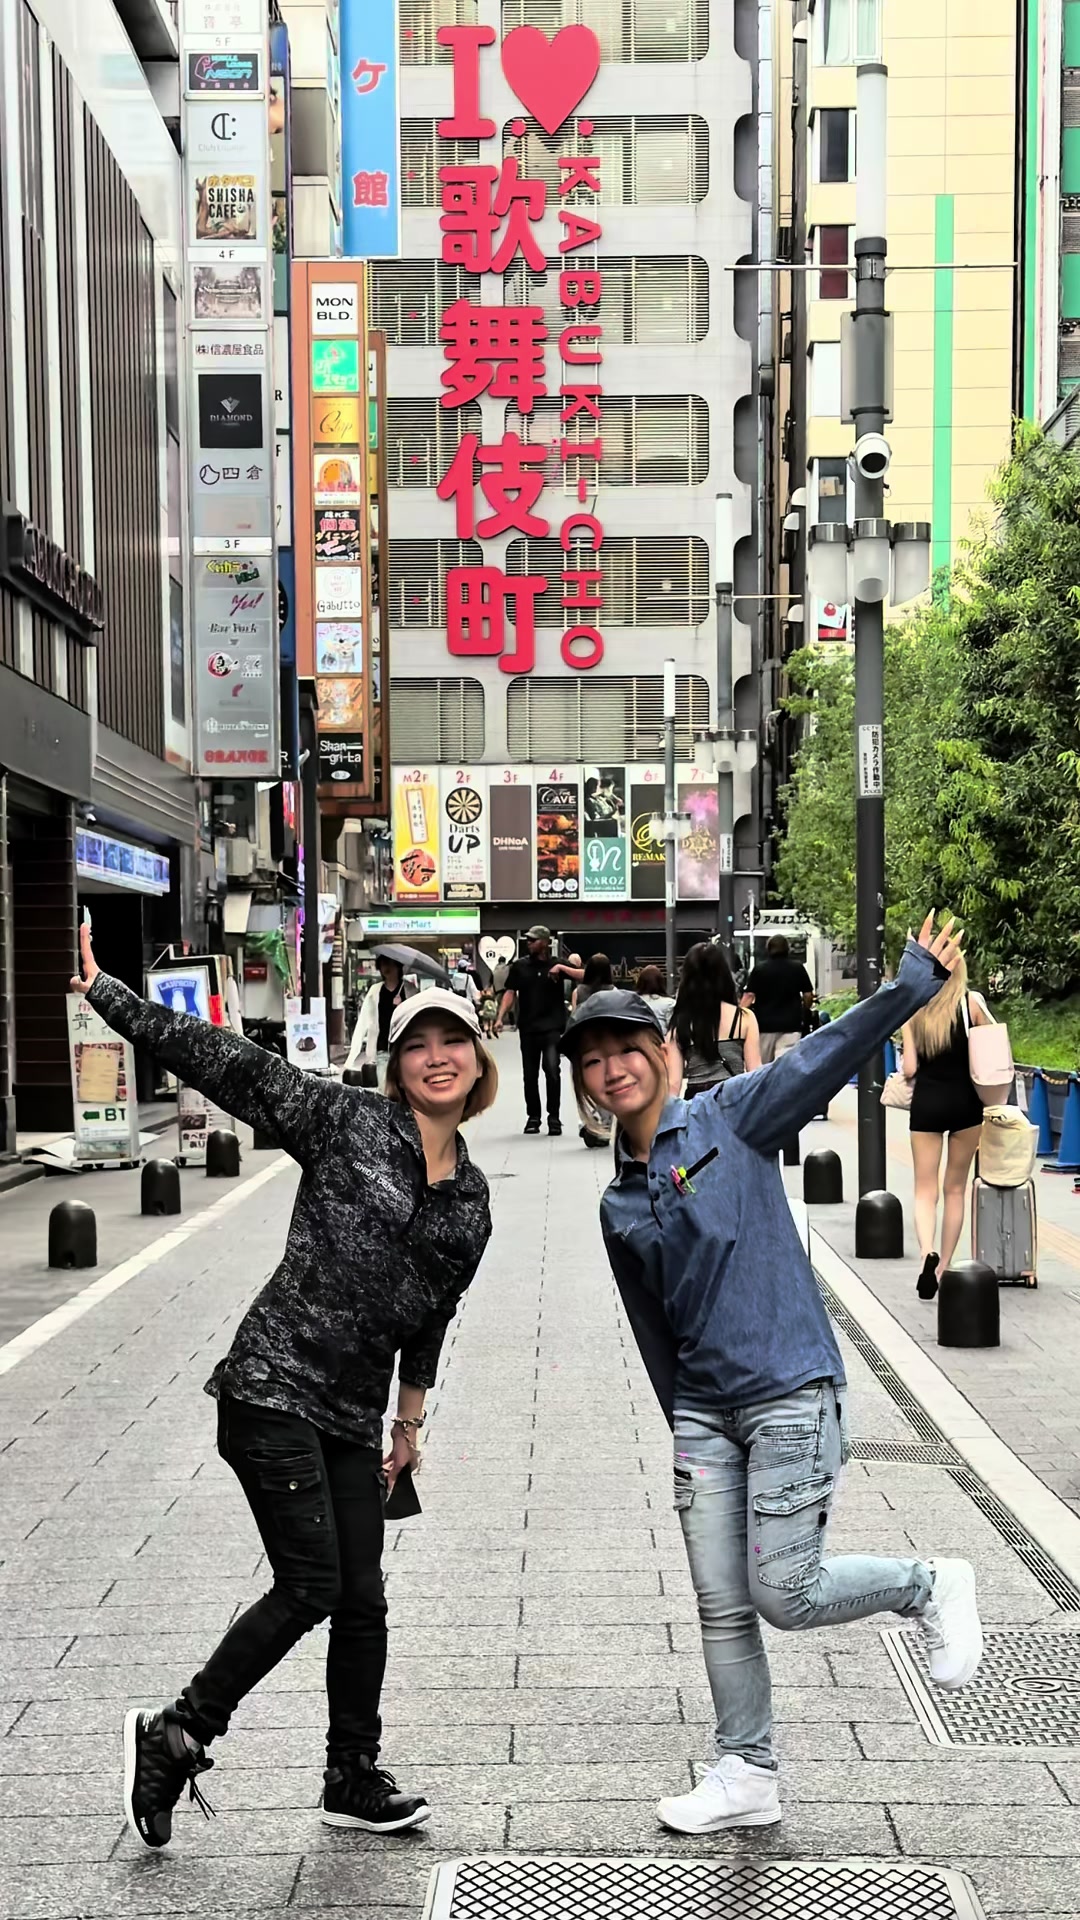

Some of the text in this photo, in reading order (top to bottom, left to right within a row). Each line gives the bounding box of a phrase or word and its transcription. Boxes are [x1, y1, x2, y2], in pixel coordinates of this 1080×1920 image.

[436, 25, 496, 138] I
[208, 188, 254, 202] SHISHA
[208, 203, 236, 219] CAFE
[316, 297, 353, 306] MON
[317, 311, 353, 320] BLD.
[210, 414, 253, 422] DIAMOND
[435, 156, 550, 674] 歌舞伎町
[557, 157, 604, 670] KABUKI-CHO
[316, 600, 360, 613] Gabutto
[403, 769, 429, 783] M2F
[456, 770, 472, 784] 2F
[503, 770, 518, 784] 3F
[549, 769, 564, 781] 4F
[449, 824, 480, 833] Darts
[448, 834, 481, 853] UP
[584, 876, 625, 885] NAROZ
[382, 920, 432, 929] FamilyMart
[158, 980, 197, 989] LAWSON
